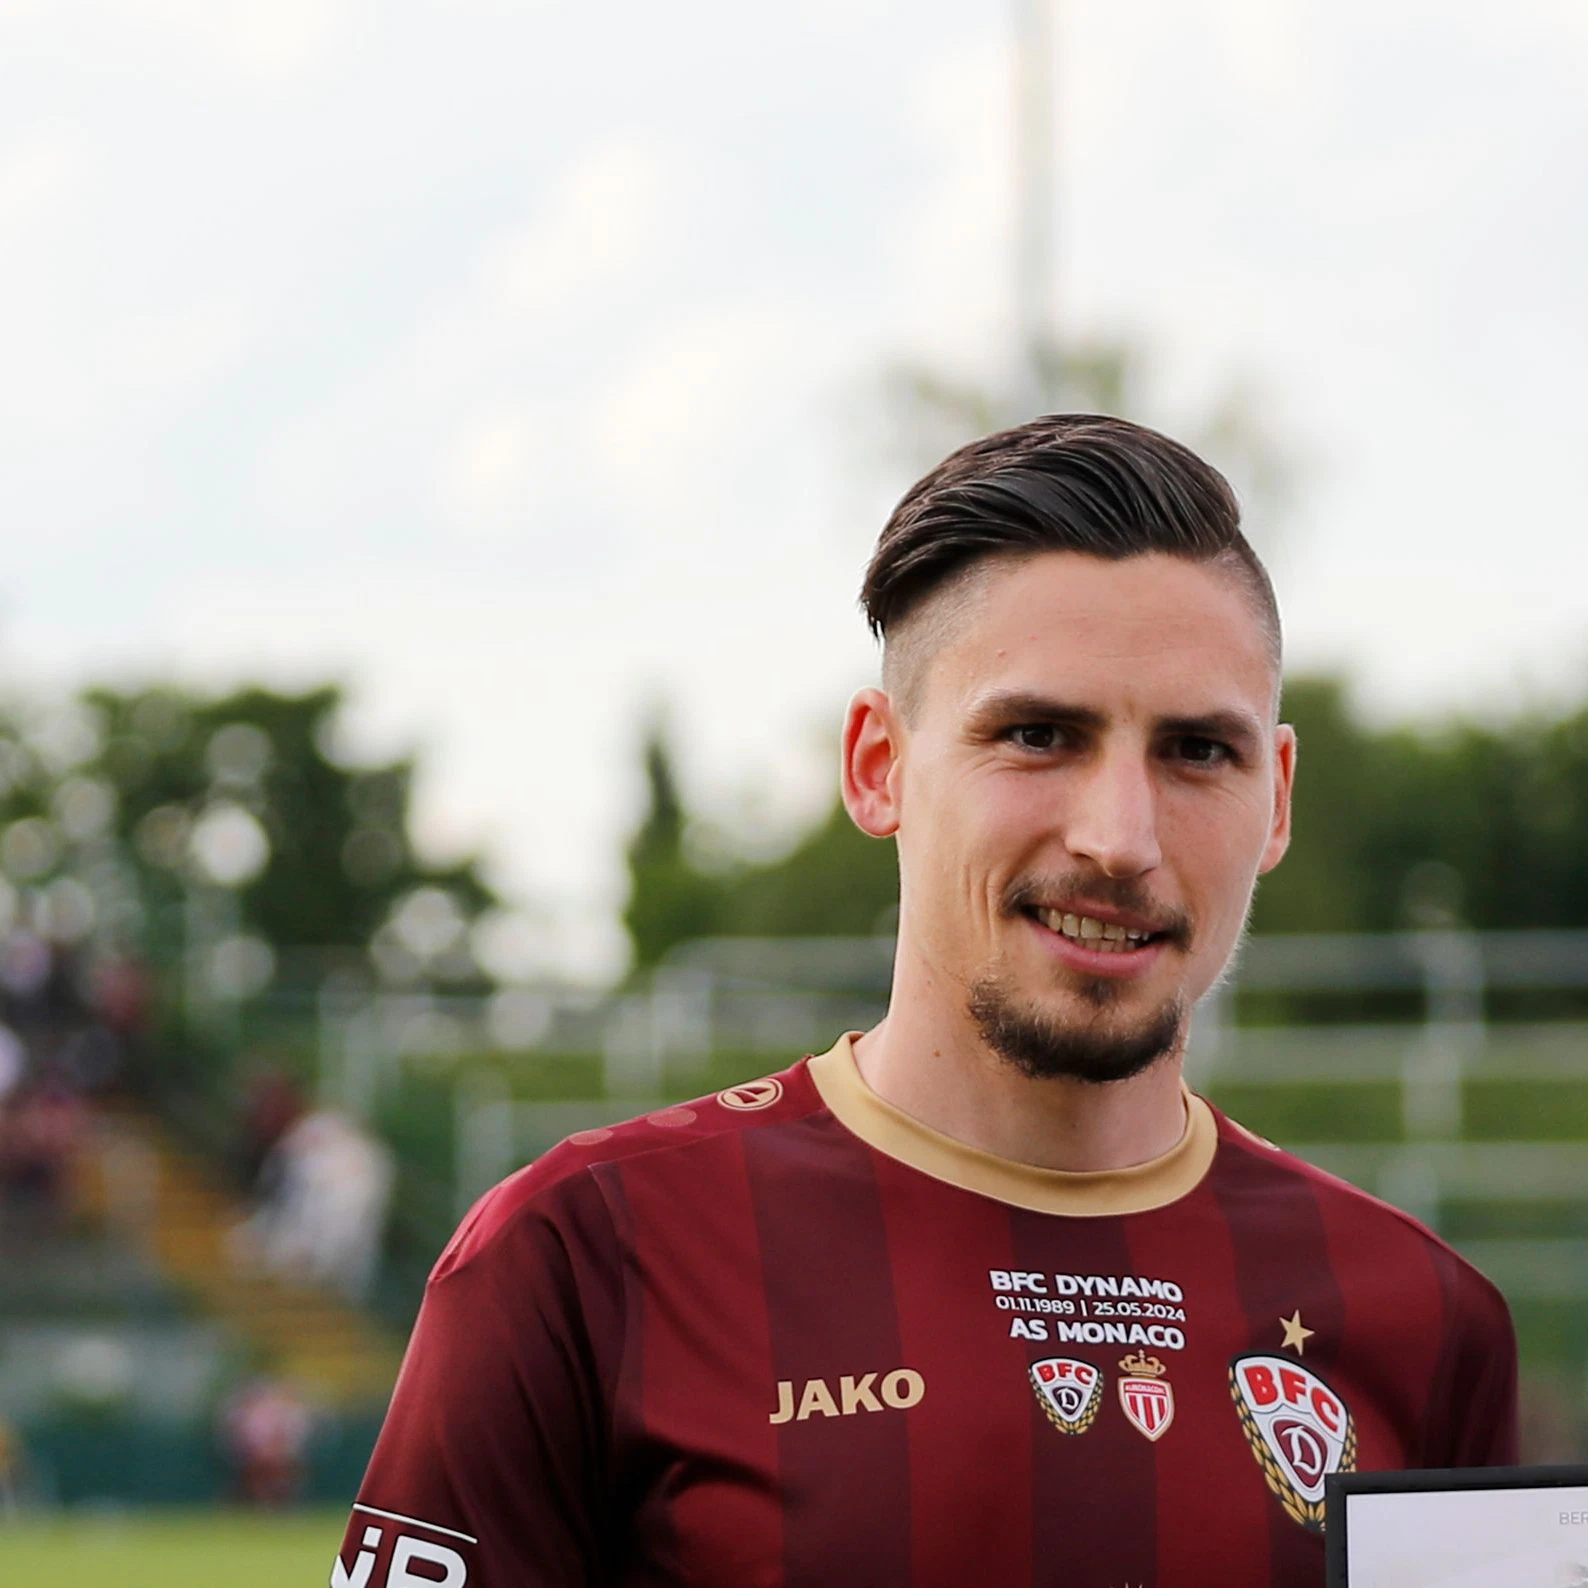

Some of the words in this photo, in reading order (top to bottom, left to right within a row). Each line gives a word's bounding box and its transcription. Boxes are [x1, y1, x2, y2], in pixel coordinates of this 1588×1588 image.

[989, 1270, 1047, 1293] BFC
[1055, 1274, 1183, 1302] DYNAMO
[995, 1296, 1075, 1314] 01.11.1989
[1093, 1302, 1186, 1322] 25.05.2024
[1010, 1318, 1048, 1340] AS
[1057, 1321, 1185, 1350] MONACO
[1036, 1362, 1094, 1386] BFC
[769, 1368, 925, 1424] JAKO
[1243, 1365, 1340, 1433] BFC
